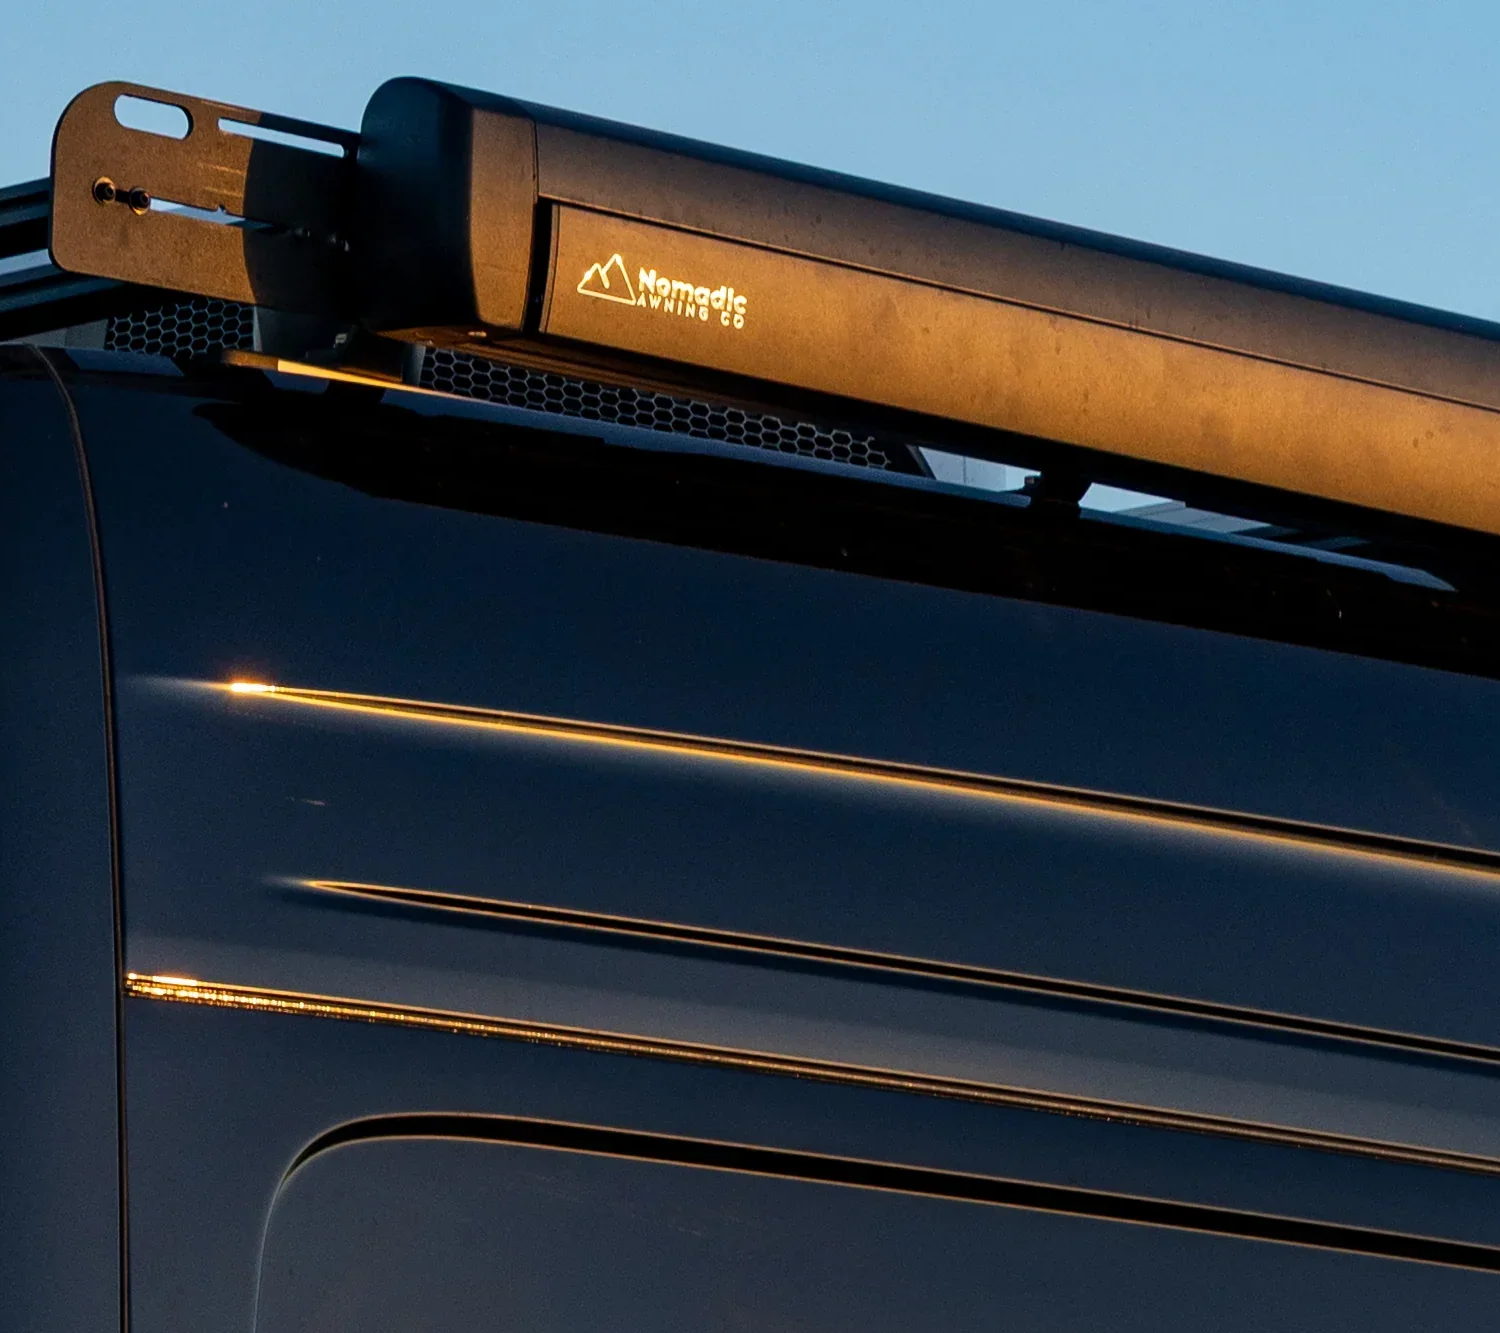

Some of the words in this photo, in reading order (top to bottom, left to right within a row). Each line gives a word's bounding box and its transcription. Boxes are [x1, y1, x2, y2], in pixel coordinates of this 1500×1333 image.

[637, 292, 709, 321] AWNING
[720, 311, 744, 328] CO
[638, 267, 747, 314] Nomadic
